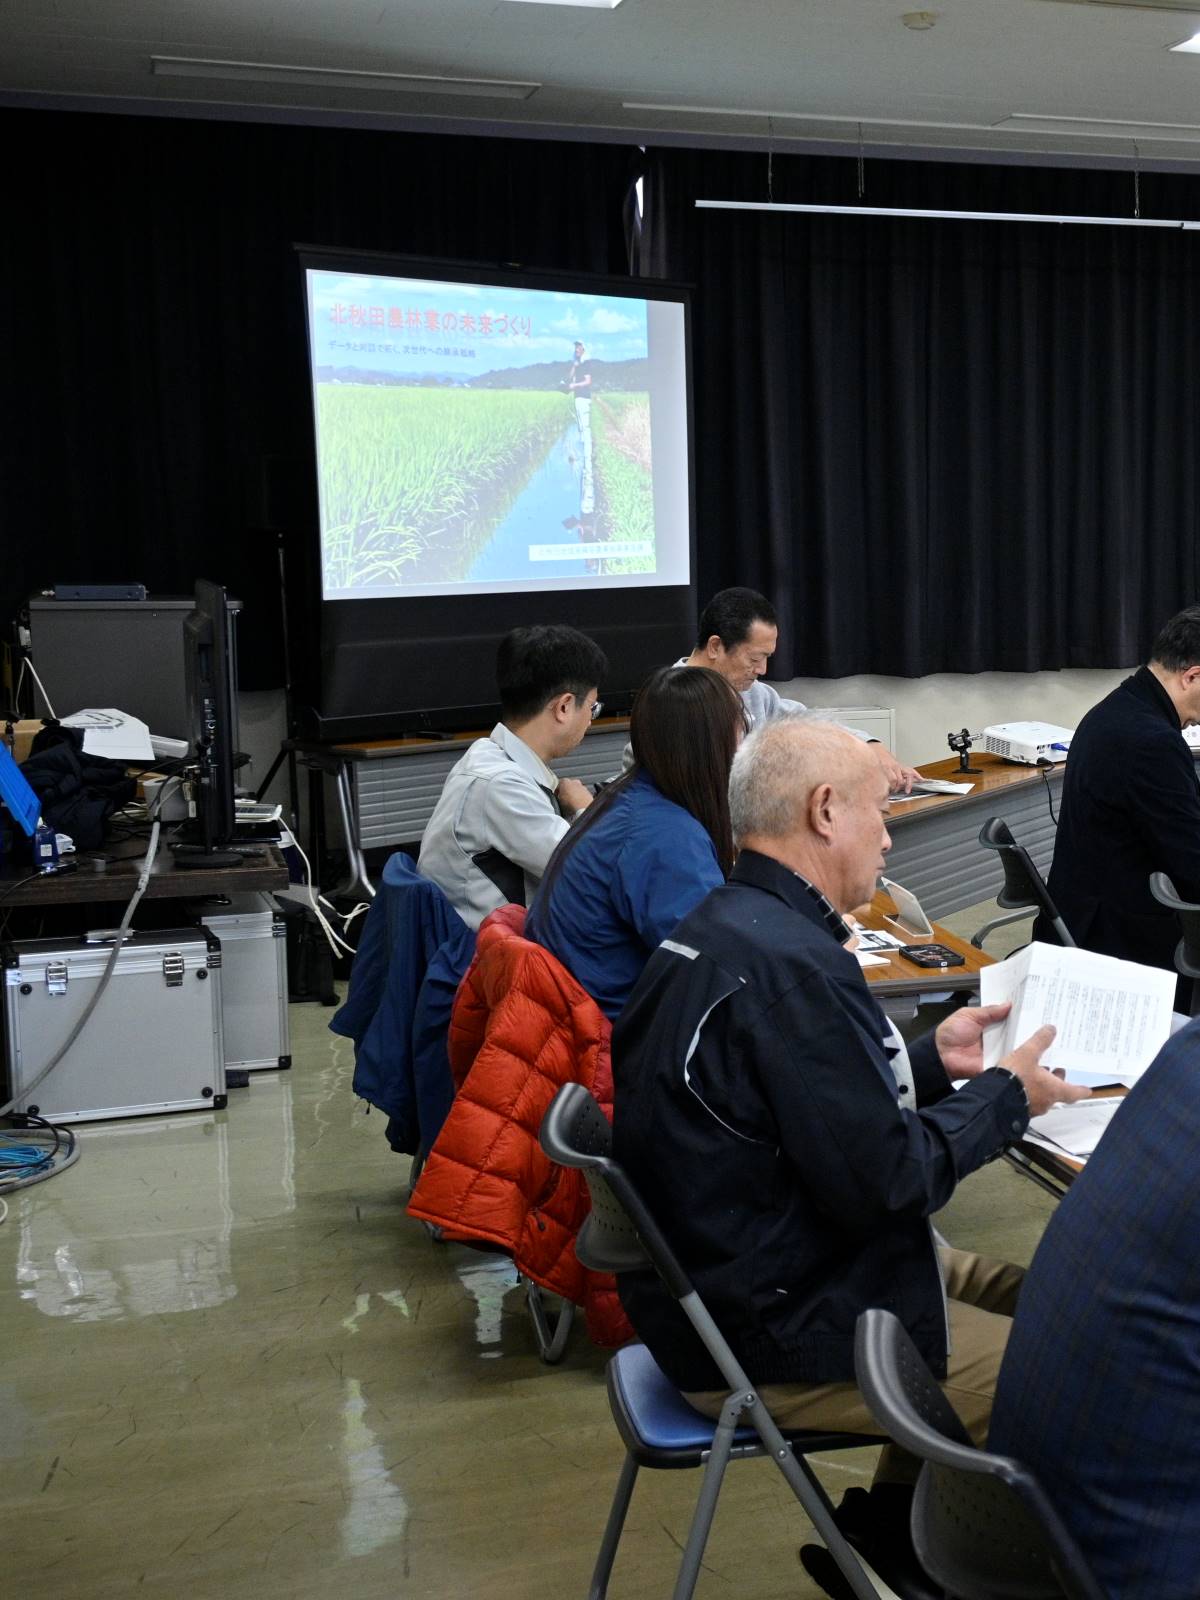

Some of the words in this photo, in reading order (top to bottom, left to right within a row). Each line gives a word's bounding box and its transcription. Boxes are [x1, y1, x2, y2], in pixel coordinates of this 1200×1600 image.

[329, 303, 532, 337] 北秋田農林業の未来づくり
